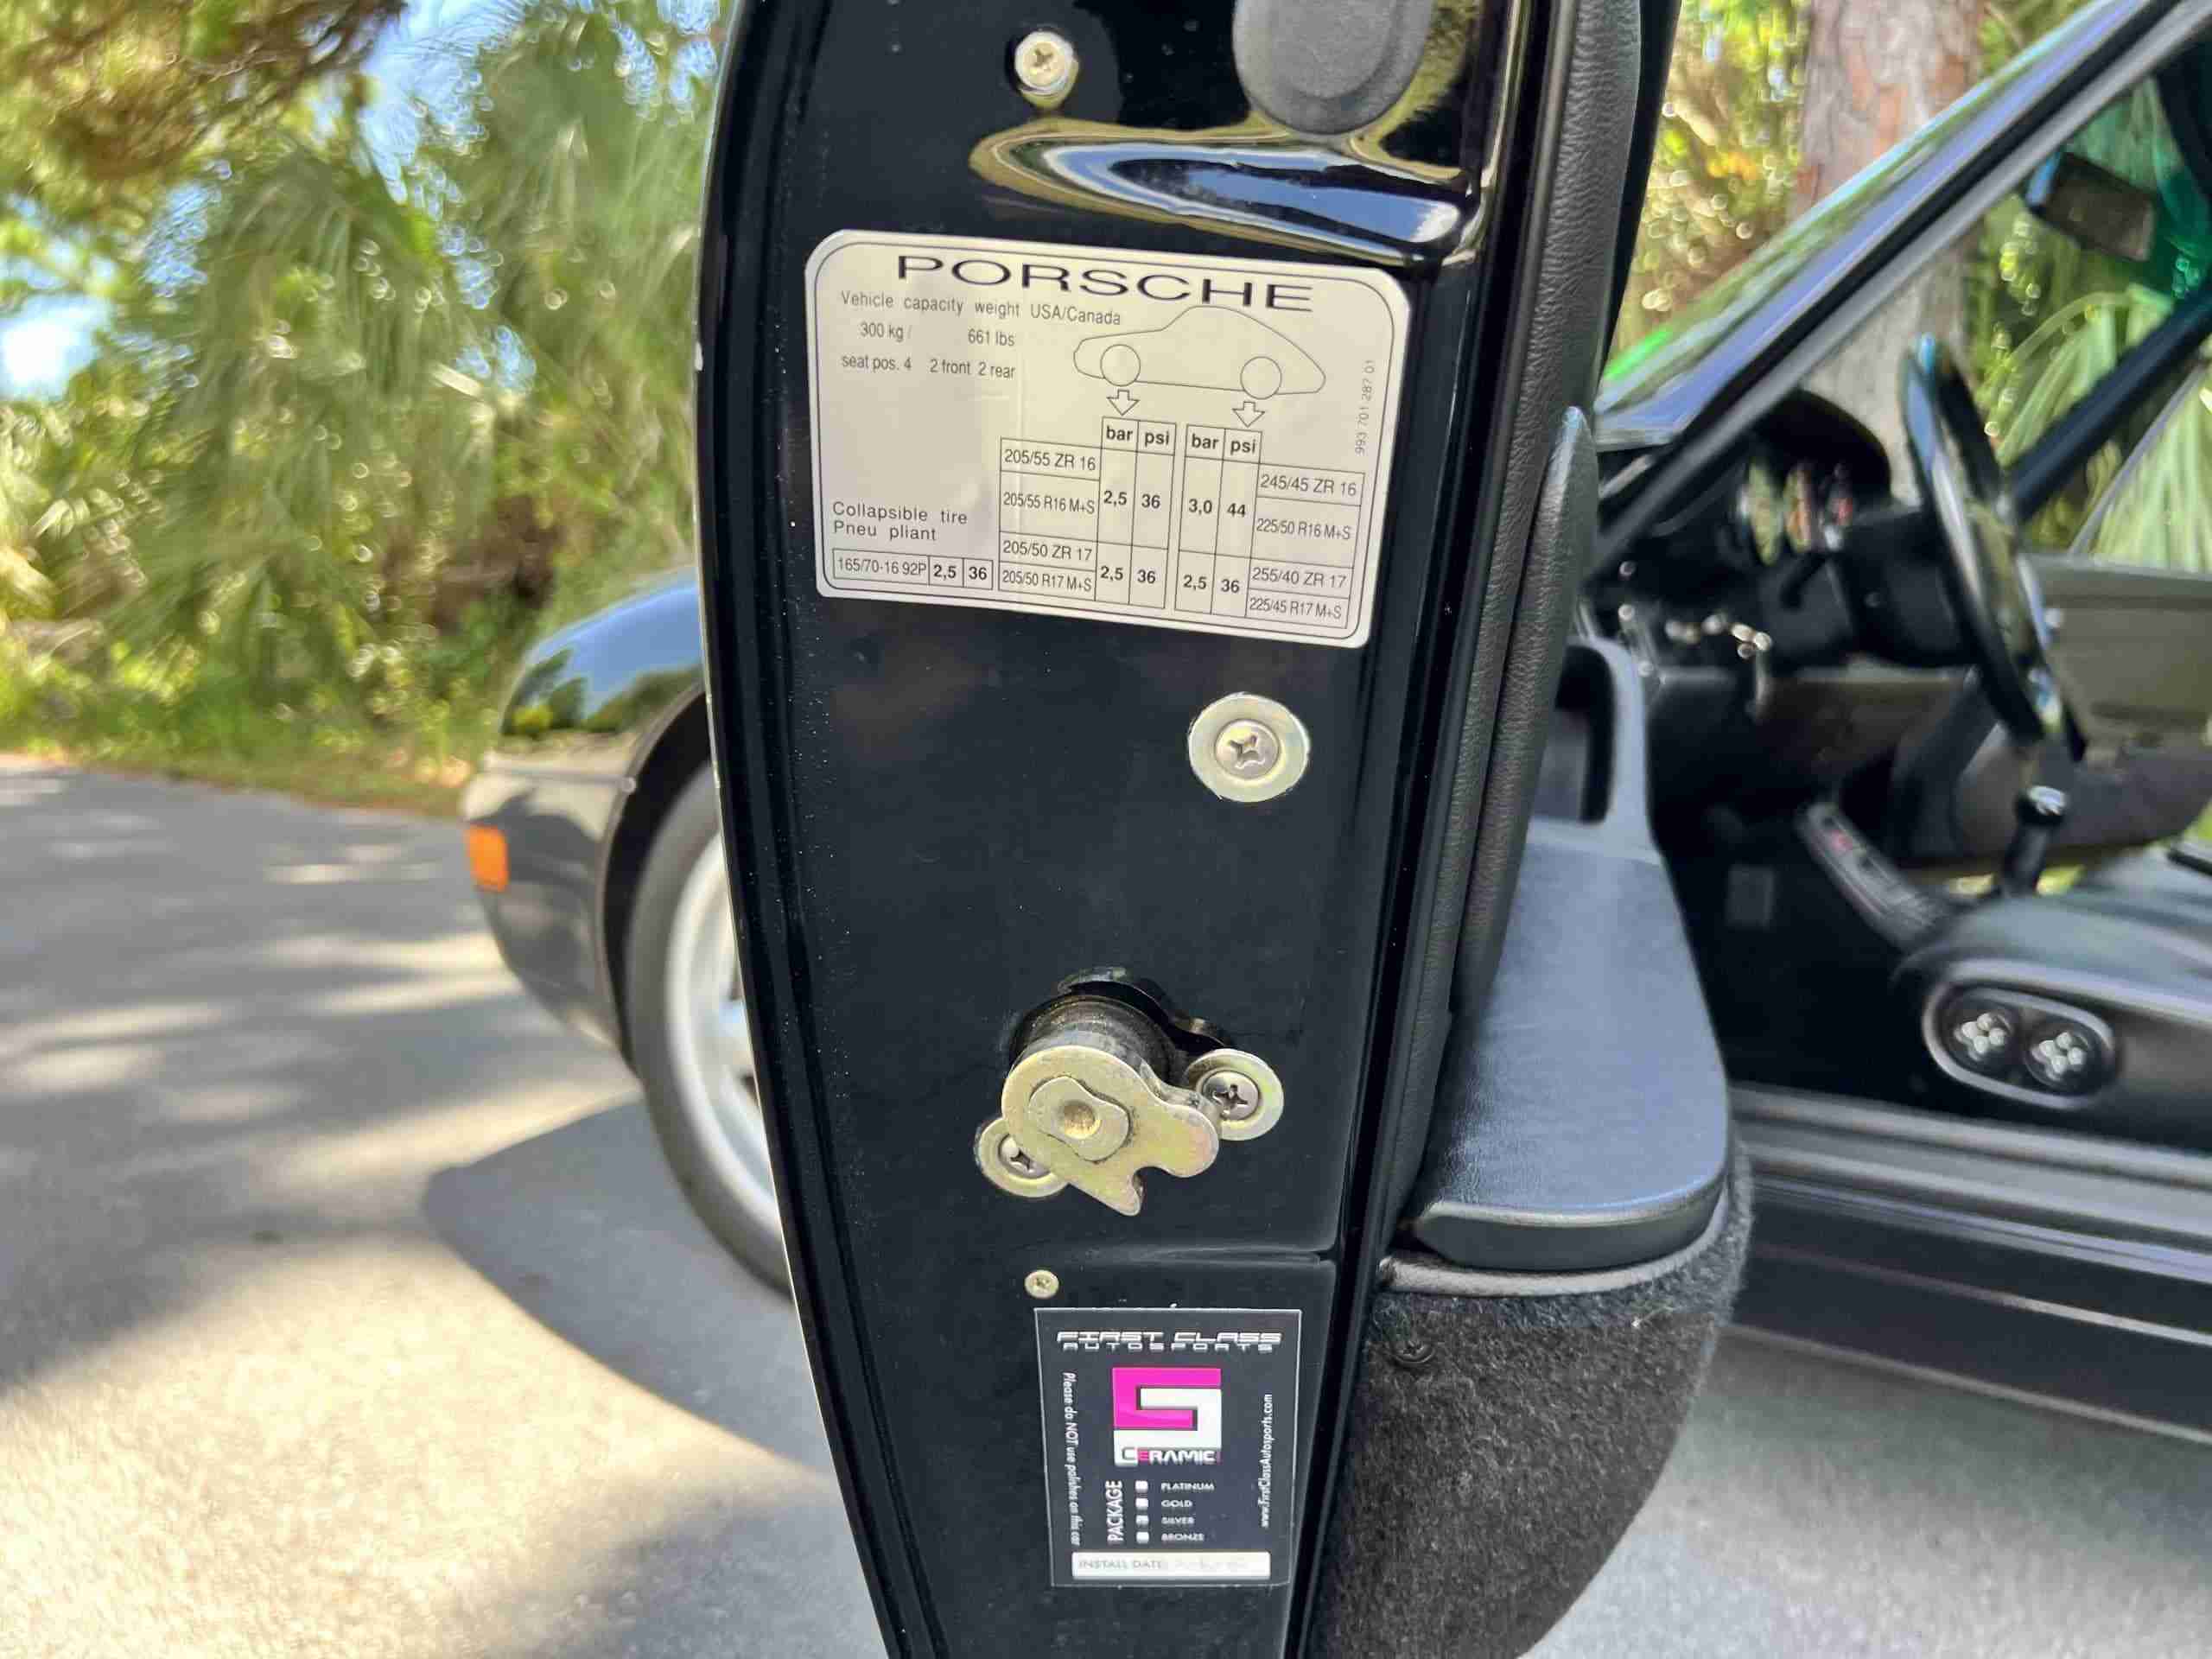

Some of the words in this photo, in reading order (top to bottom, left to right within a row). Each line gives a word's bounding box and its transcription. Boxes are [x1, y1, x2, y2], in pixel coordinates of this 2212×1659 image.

[898, 255, 1313, 312] PORSCHE
[841, 289, 894, 308] Vehicle
[903, 296, 964, 317] capacity
[975, 301, 1020, 319] weight
[1031, 305, 1122, 325] USA/Canada
[860, 321, 885, 338] 300
[888, 324, 904, 342] kg
[968, 329, 990, 345] 661
[995, 329, 1015, 346] lbs
[841, 354, 869, 369] seat
[873, 357, 899, 373] pos.
[903, 356, 912, 371] 4
[930, 358, 938, 373] 2
[942, 359, 971, 375] front
[978, 361, 988, 377] 2
[990, 364, 1016, 379] rear
[1106, 425, 1133, 442] bar
[1144, 430, 1170, 446] psi
[1192, 433, 1218, 449] bar
[1230, 438, 1256, 454] psi
[1004, 448, 1051, 466] 205/55
[1054, 451, 1075, 468] ZR
[1080, 455, 1096, 471] 16
[1260, 474, 1309, 493] 245/45
[1313, 477, 1335, 494] ZR
[1340, 481, 1357, 497] 16
[1003, 492, 1041, 509] 205/55
[1044, 493, 1066, 512] R16
[1069, 496, 1096, 514] M+S
[1103, 490, 1128, 506] 2,5
[1141, 493, 1160, 509] 36
[833, 501, 928, 521] Collapsible
[941, 511, 968, 524] tire
[1188, 499, 1212, 515] 3,0
[1227, 503, 1246, 518] 44
[834, 520, 877, 537] Pneu
[890, 524, 937, 541] pliant
[1298, 520, 1320, 537] R16
[1003, 540, 1049, 557] 205/50
[1052, 542, 1072, 560] ZR
[1077, 545, 1093, 561] 17
[902, 562, 926, 575] 92P
[933, 563, 957, 580] 2,5
[969, 566, 988, 581] 36
[1100, 565, 1124, 582] 2,5
[1137, 569, 1156, 584] 36
[1042, 573, 1064, 588] R17
[1183, 574, 1207, 590] 2,5
[1221, 578, 1240, 593] 36
[1252, 567, 1300, 585] 255/40
[1303, 570, 1324, 586] ZR
[1330, 575, 1346, 588] 17
[1289, 600, 1313, 615] R17
[1057, 1331, 1164, 1343] FIRST
[1174, 1332, 1282, 1344] CLASS
[1063, 1372, 1076, 1404] Please
[1064, 1406, 1077, 1421] do
[1065, 1421, 1078, 1446] NOT
[1066, 1446, 1077, 1463] use
[1160, 1482, 1215, 1491] PLATINUM
[1105, 1479, 1123, 1542] PACKAGE
[1160, 1499, 1193, 1508] GOLD
[1160, 1516, 1195, 1525] SILVER
[1160, 1533, 1205, 1541] BRONZE
